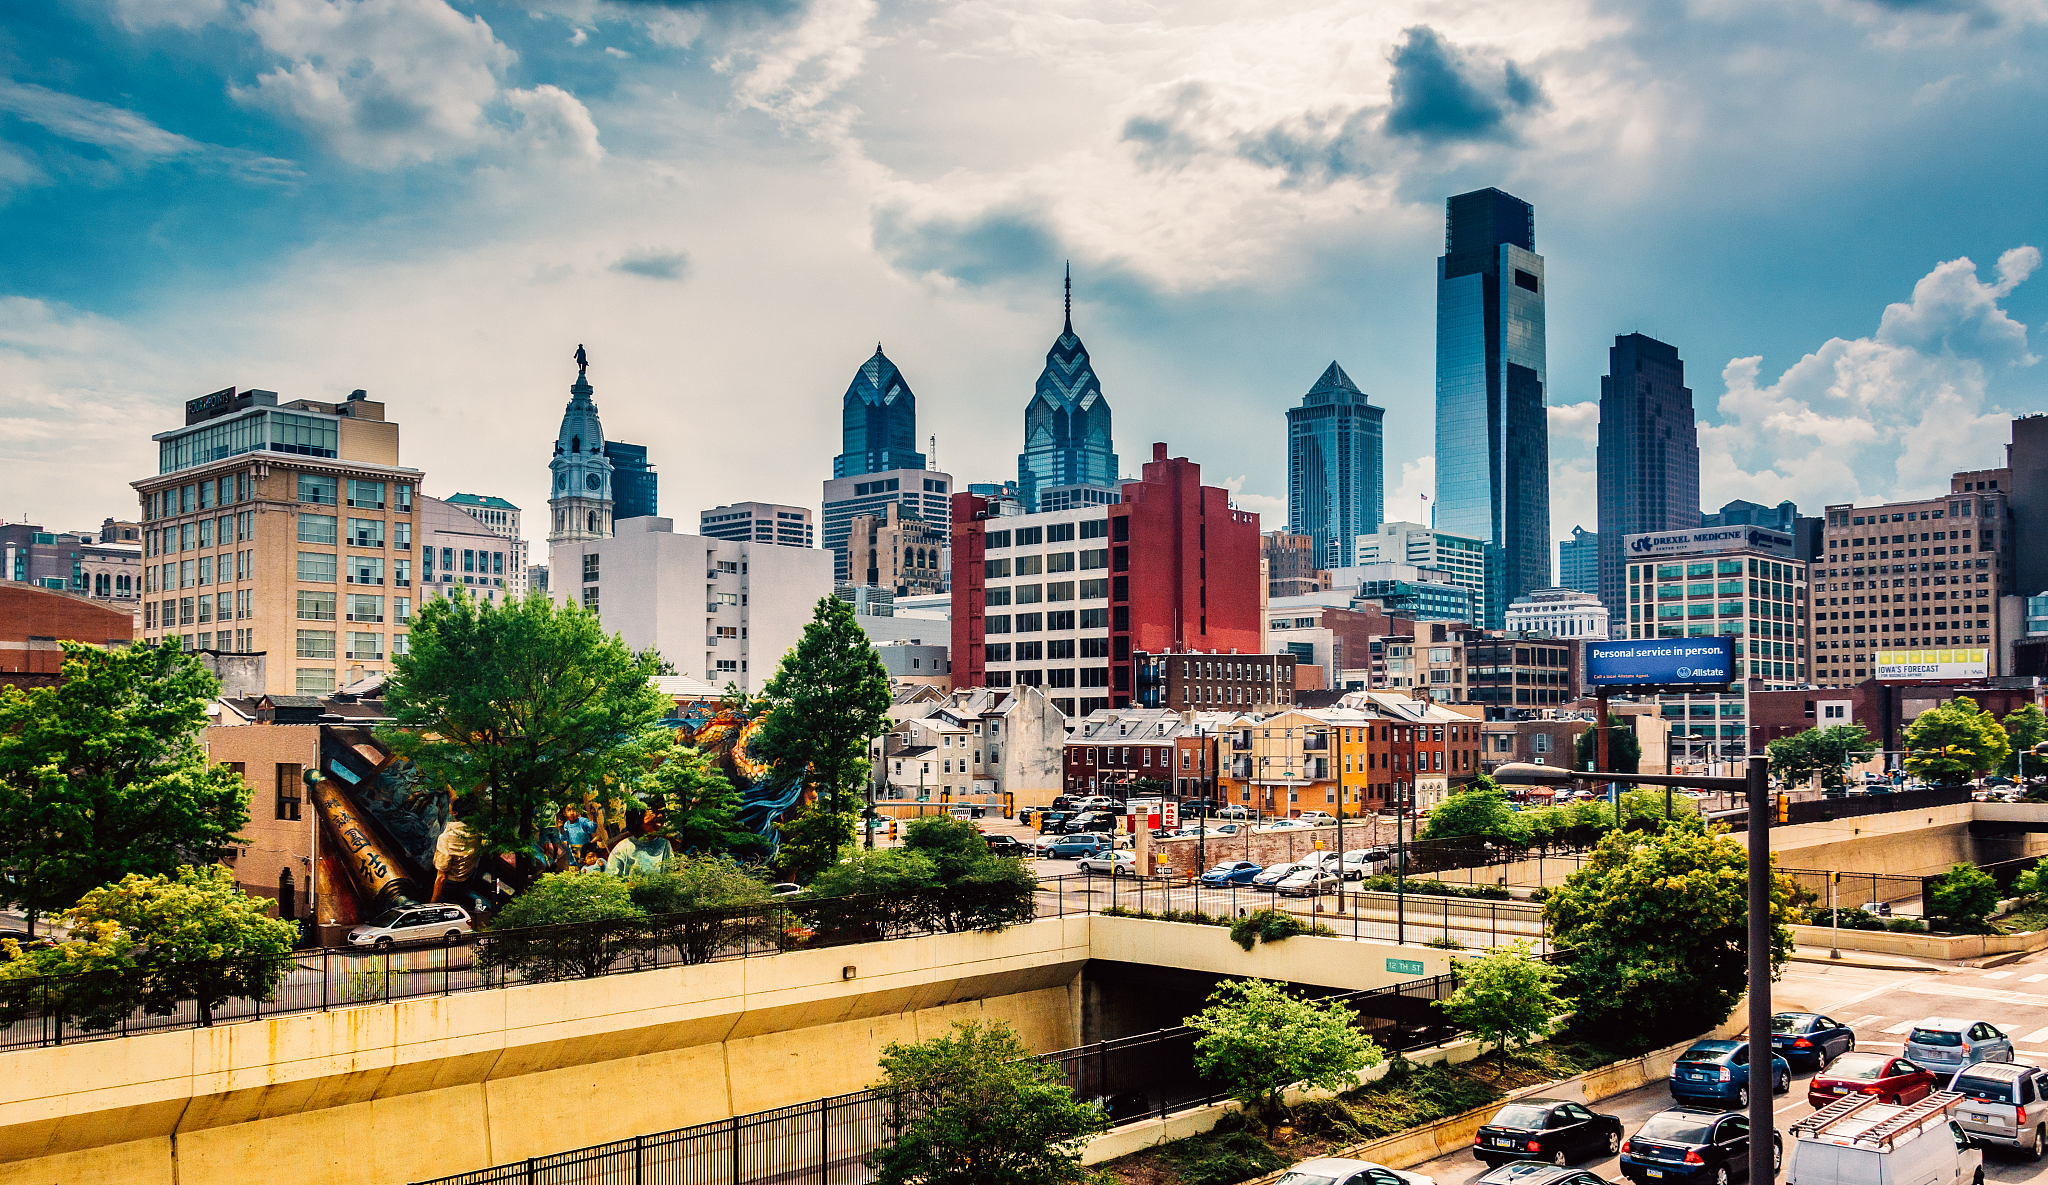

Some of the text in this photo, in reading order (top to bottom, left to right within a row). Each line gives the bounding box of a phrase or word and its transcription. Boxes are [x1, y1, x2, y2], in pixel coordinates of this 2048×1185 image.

[189, 400, 204, 413] FOUR
[1653, 535, 1690, 546] DREXEL
[1693, 531, 1741, 543] MEDICINE
[1593, 646, 1723, 658] Personal service in person.
[1691, 668, 1724, 677] Allstate
[1878, 665, 1939, 674] IOWA'S FORECAST
[1165, 803, 1175, 826] PARK
[1388, 961, 1420, 972] 12 TH ST
